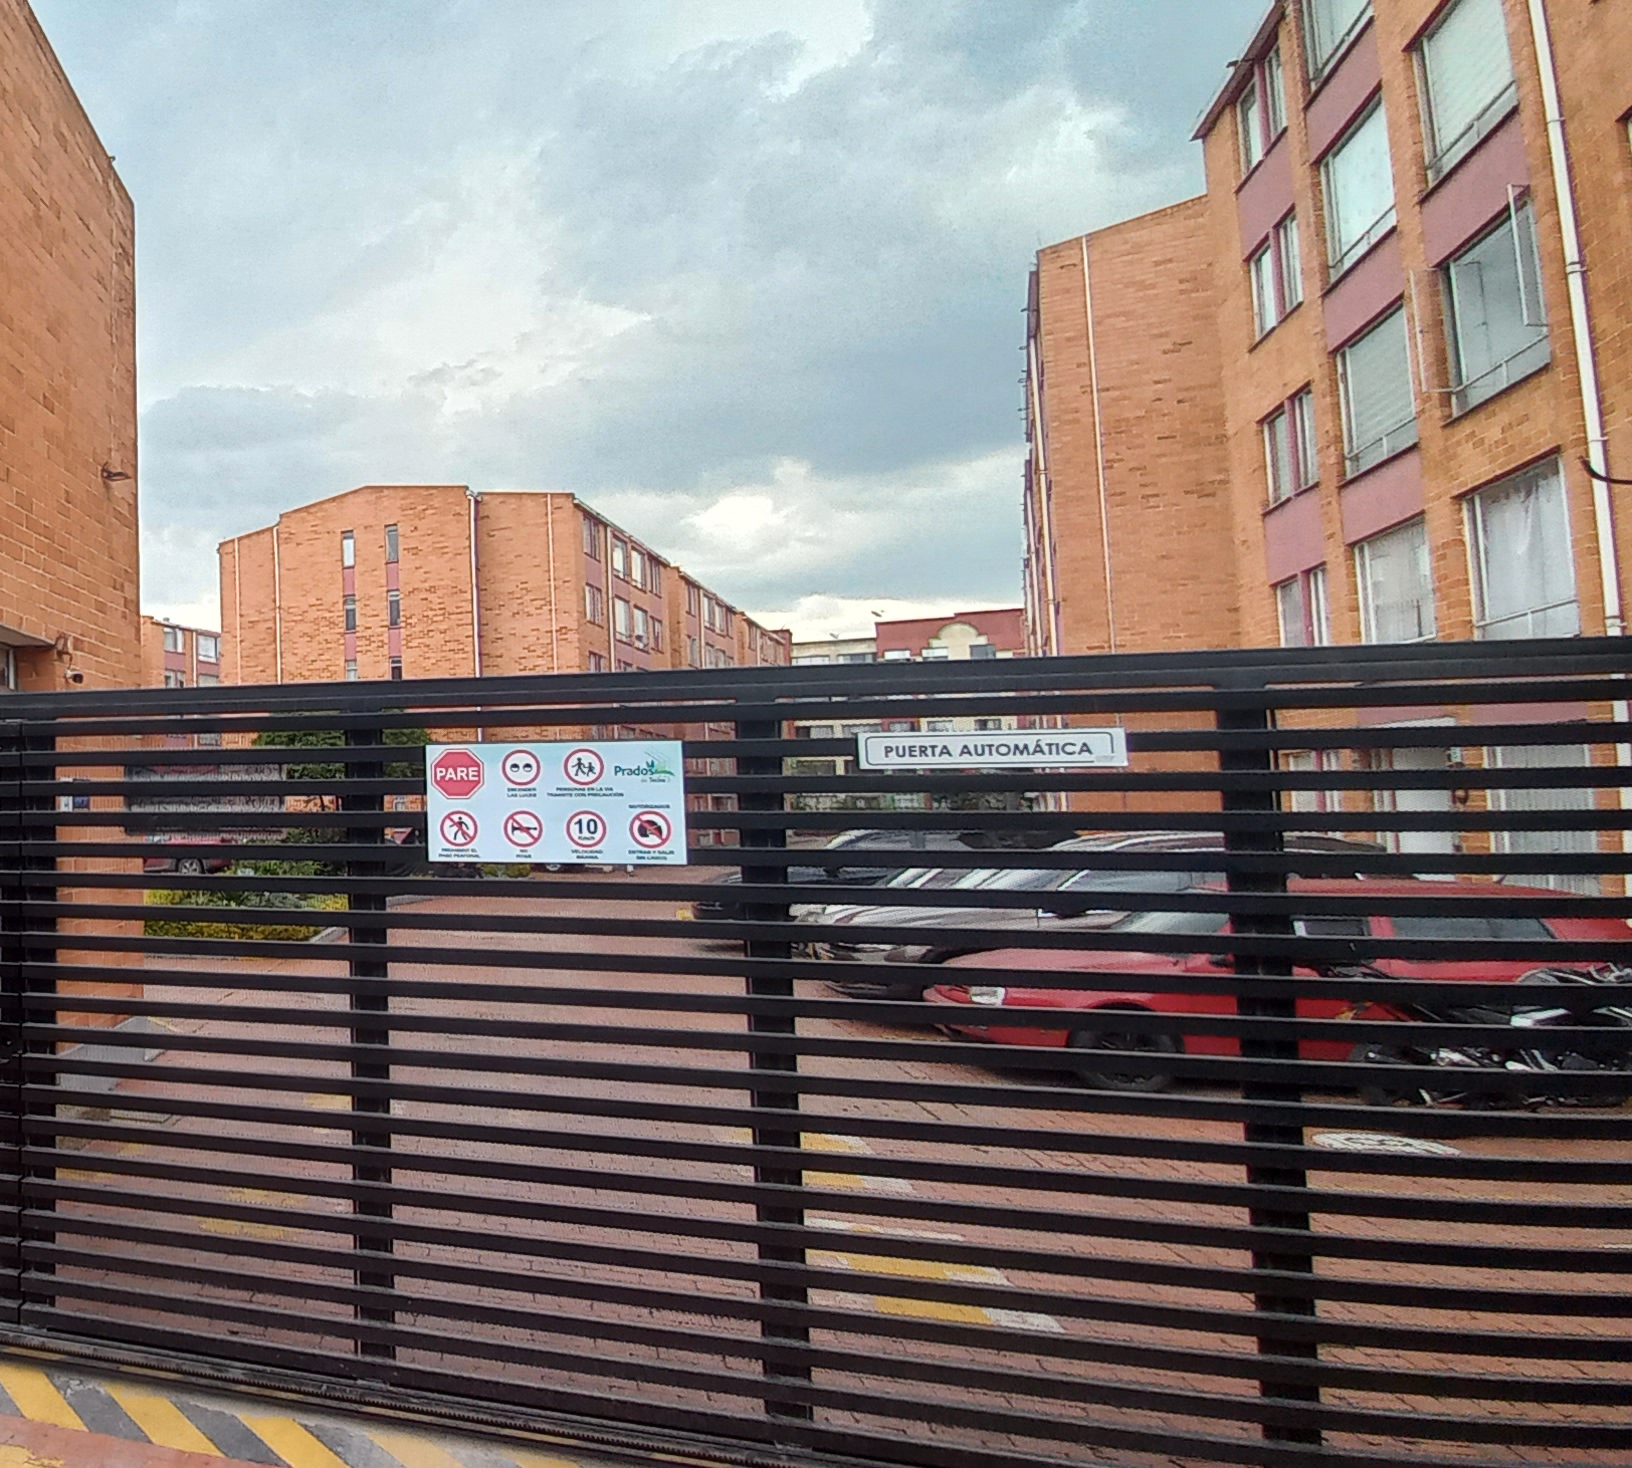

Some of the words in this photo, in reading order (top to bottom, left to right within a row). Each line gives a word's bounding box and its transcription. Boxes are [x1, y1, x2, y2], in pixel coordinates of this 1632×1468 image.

[883, 743, 953, 758] PUERTA
[958, 739, 1093, 757] AUTOMÁTICA
[436, 767, 479, 781] PARE
[614, 765, 655, 776] Prados
[574, 818, 598, 835] 10
